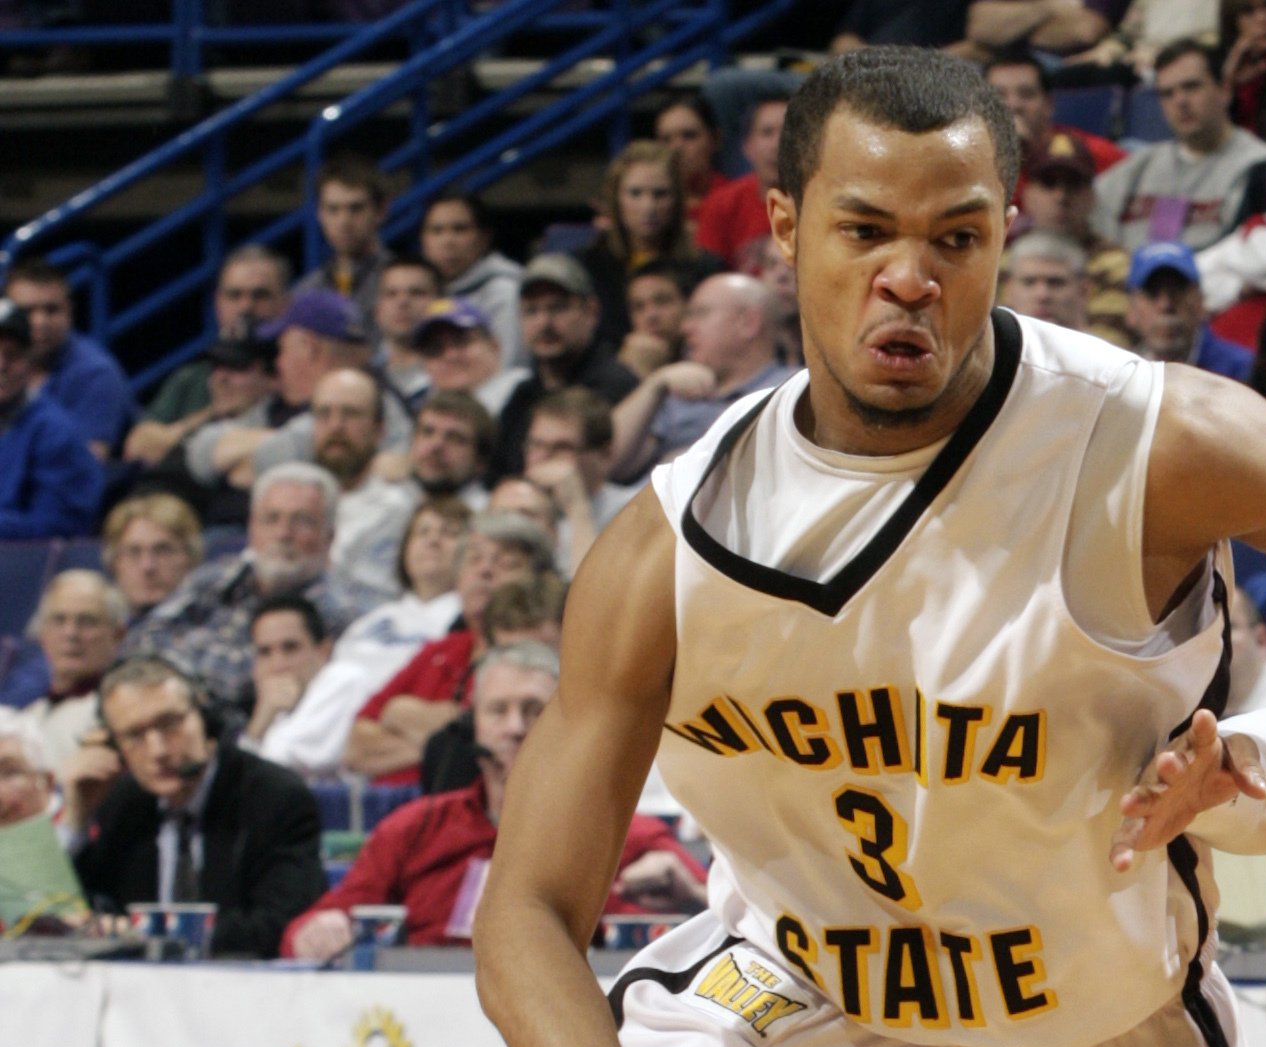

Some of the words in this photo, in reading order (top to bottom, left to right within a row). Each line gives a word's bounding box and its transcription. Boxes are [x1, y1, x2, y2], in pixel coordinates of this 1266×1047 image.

[831, 783, 923, 911] 3
[694, 952, 808, 1033] VALLEY
[744, 961, 782, 990] THE
[775, 912, 1058, 1029] STATE
